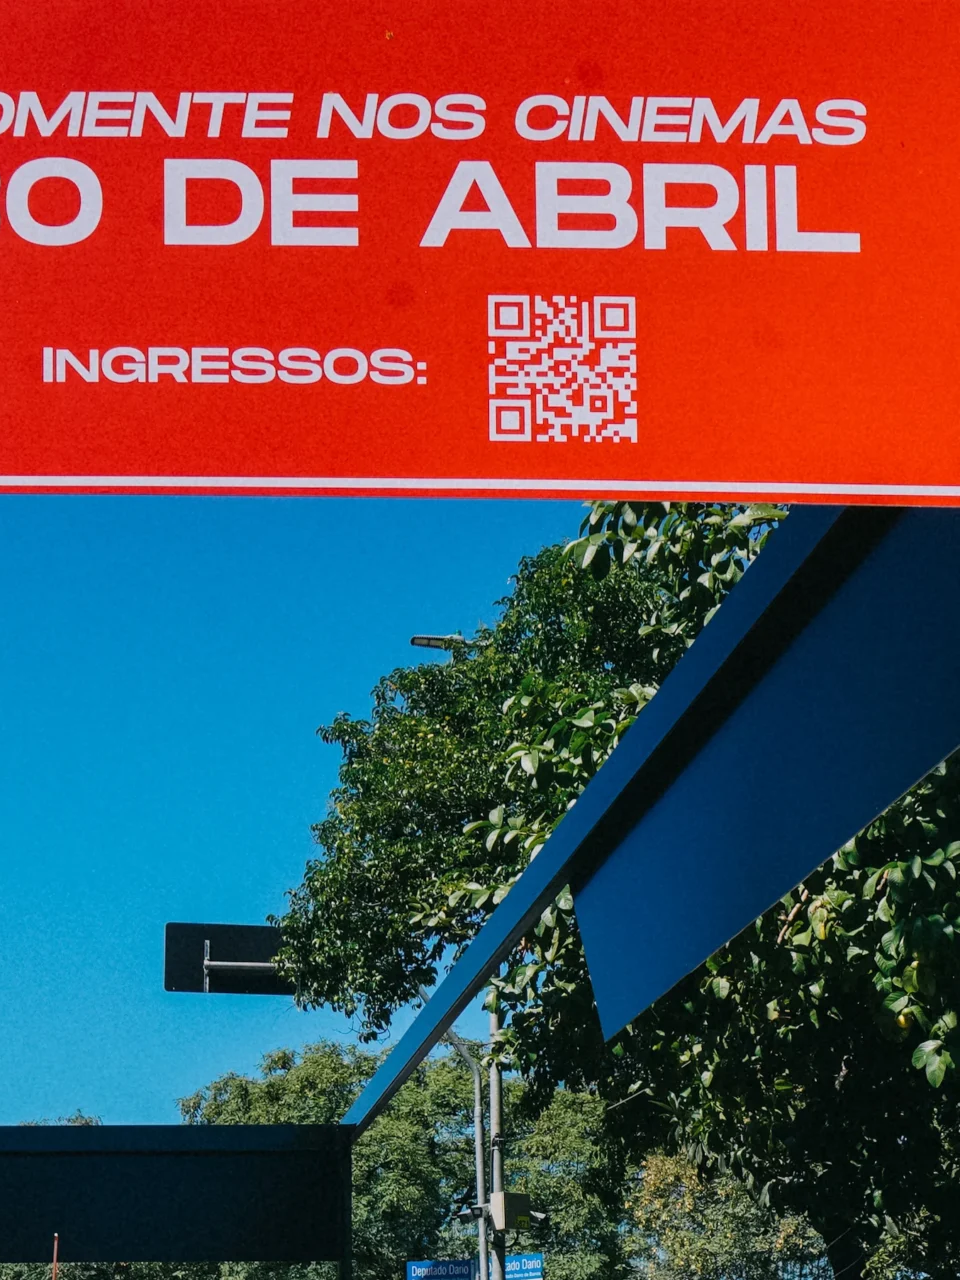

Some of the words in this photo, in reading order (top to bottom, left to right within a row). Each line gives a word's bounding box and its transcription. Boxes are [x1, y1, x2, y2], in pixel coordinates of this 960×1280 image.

[317, 93, 486, 139] NOS
[515, 95, 867, 145] CINEMAS
[164, 159, 359, 246] DE
[420, 161, 861, 253] ABRIL
[43, 346, 427, 385] INGRESSOS:
[411, 1265, 447, 1278] Deputado
